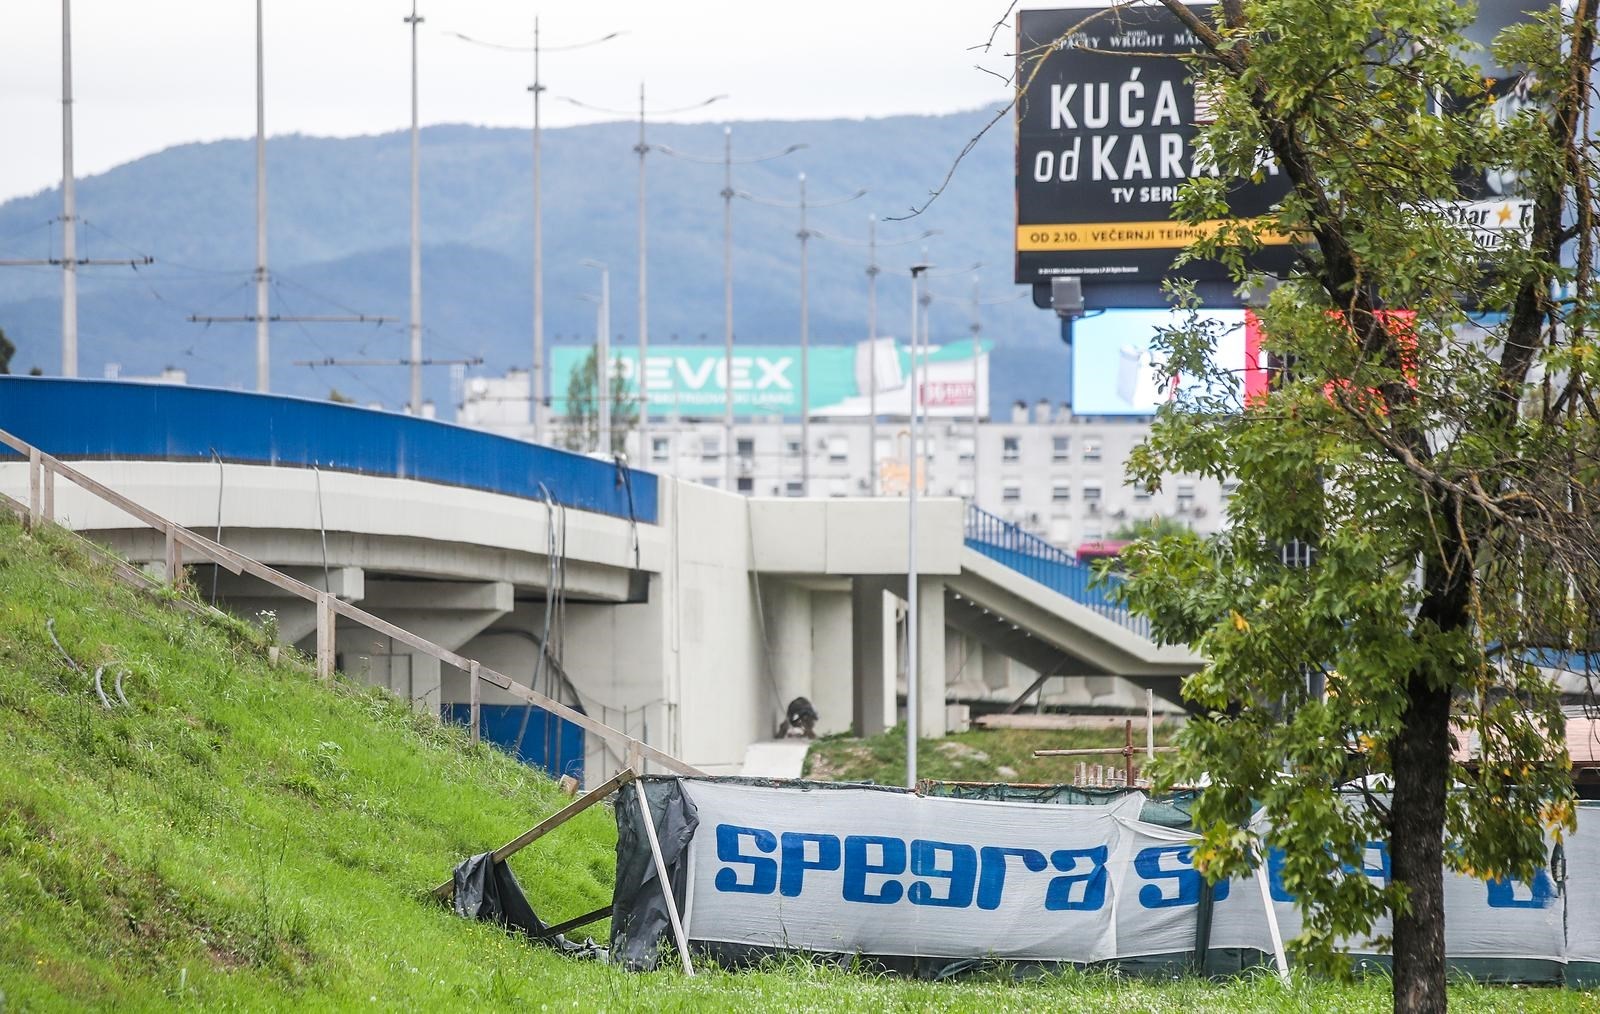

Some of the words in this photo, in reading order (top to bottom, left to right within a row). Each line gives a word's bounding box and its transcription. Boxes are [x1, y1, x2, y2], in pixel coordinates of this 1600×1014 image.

[1110, 34, 1165, 48] WRIGHT
[1051, 67, 1181, 130] KUĆA
[1034, 136, 1081, 183] od
[1112, 188, 1134, 203] TV
[1030, 232, 1050, 244] OD
[1054, 232, 1081, 244] 2.10.
[1092, 227, 1155, 242] VEČERNJI
[605, 355, 795, 390] PEVEX
